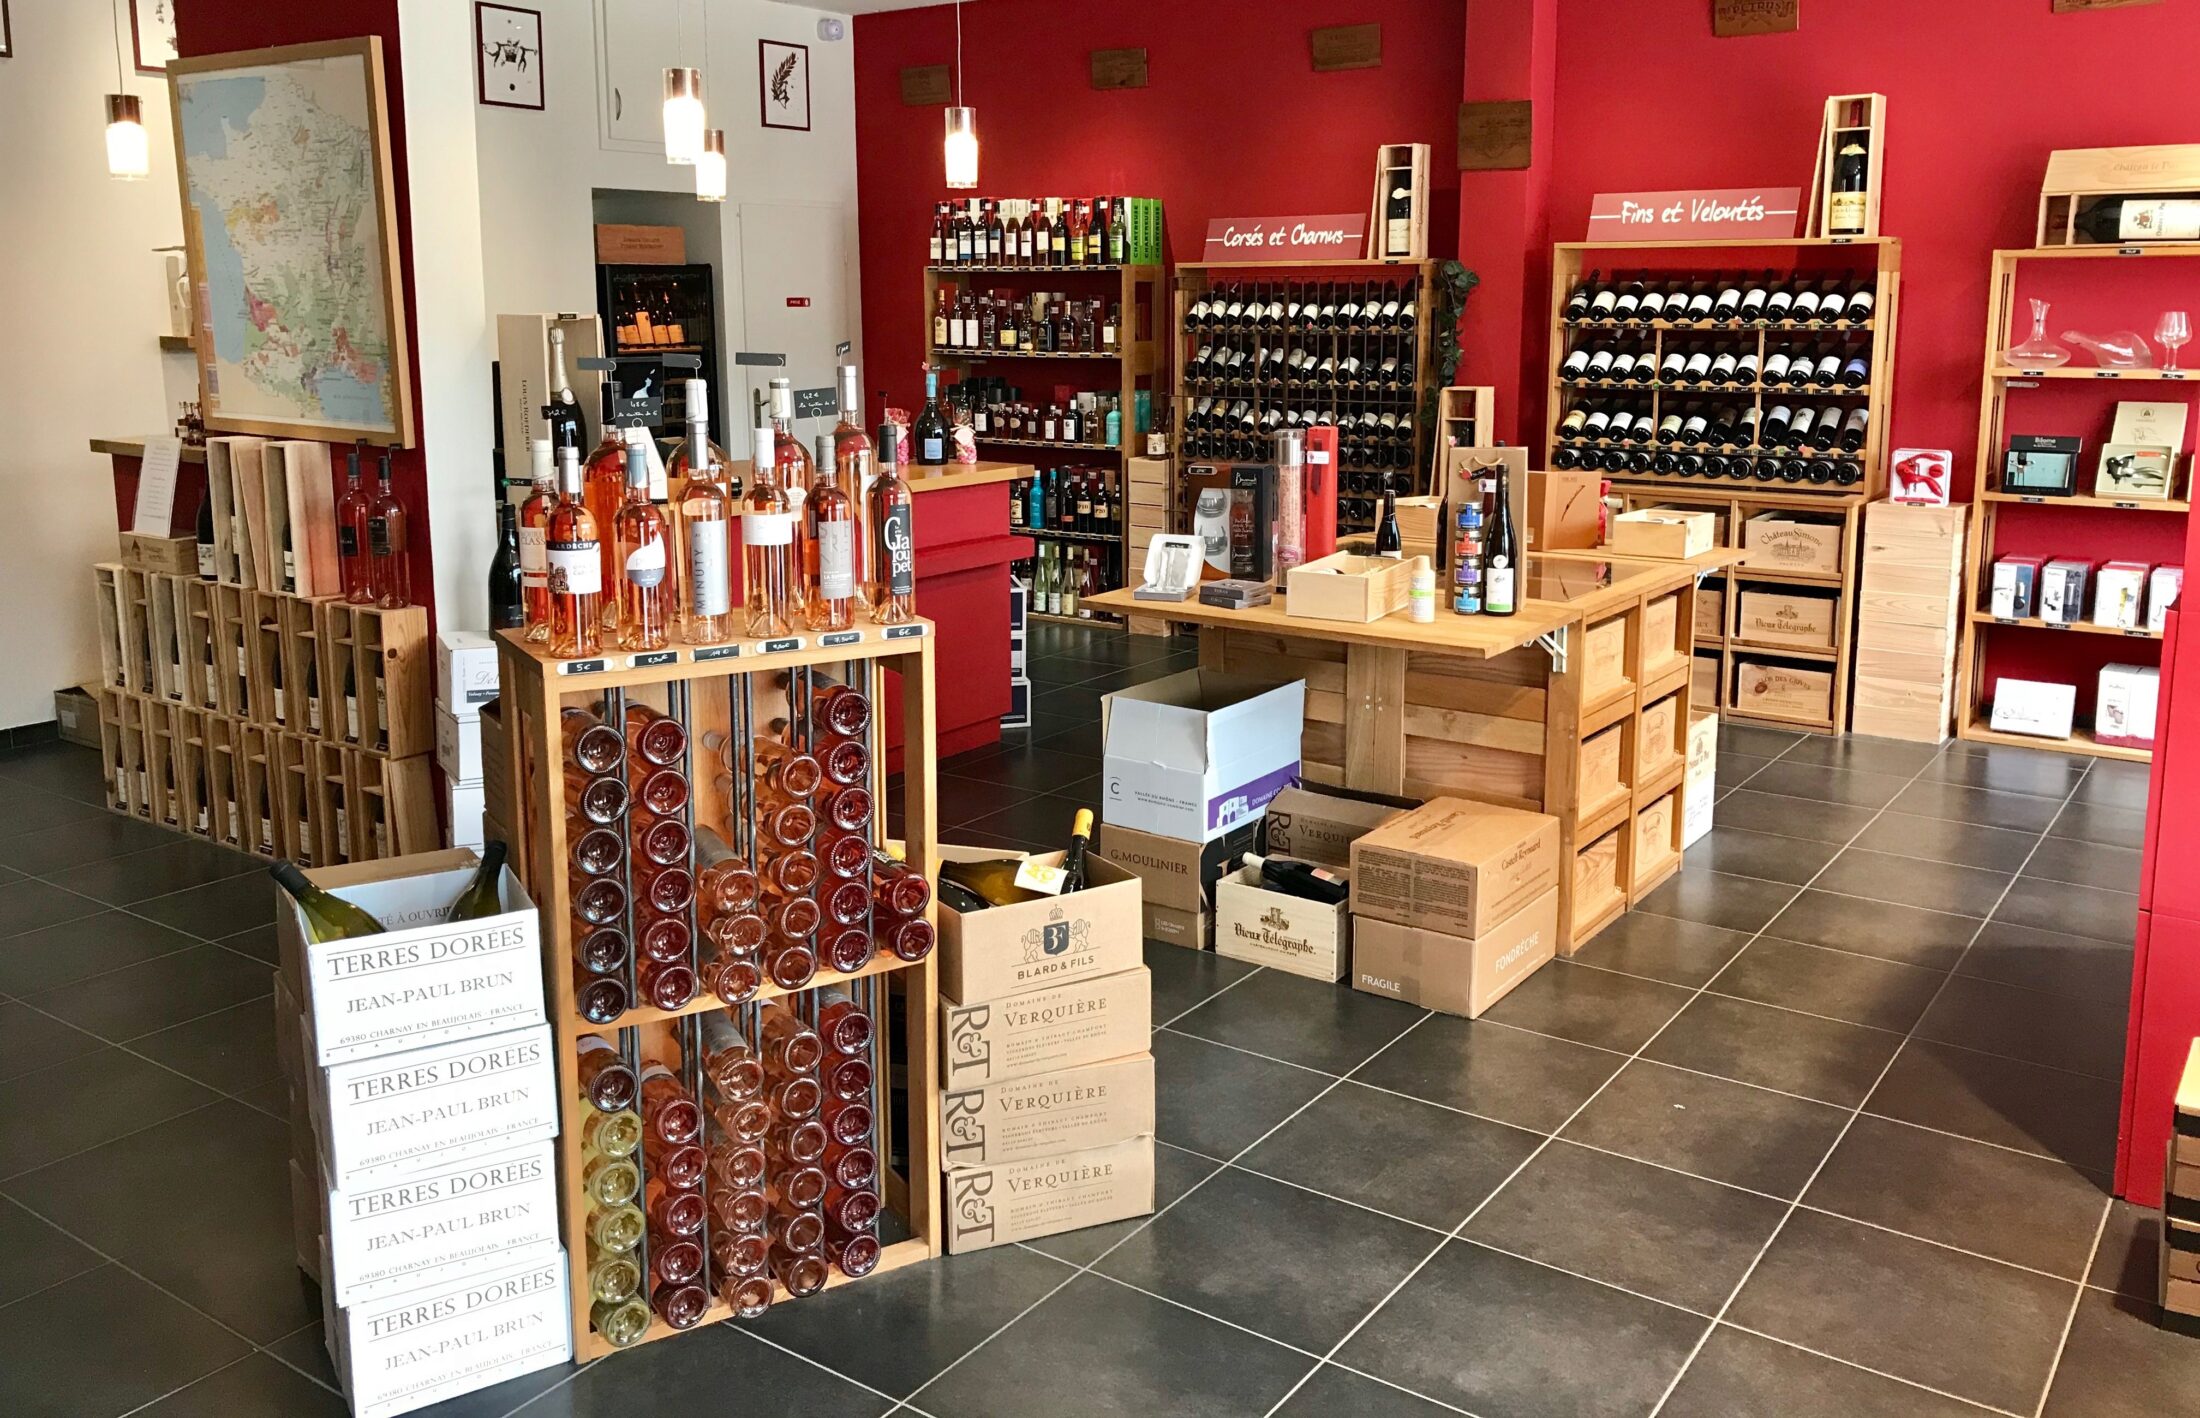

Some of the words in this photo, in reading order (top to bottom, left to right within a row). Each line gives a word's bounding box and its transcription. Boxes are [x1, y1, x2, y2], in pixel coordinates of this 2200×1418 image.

[1620, 200, 1654, 225] Fins
[1661, 200, 1684, 223] et
[1691, 195, 1765, 223] Veloutés
[1223, 224, 1264, 248] Corsés
[1268, 226, 1286, 246] et
[1290, 223, 1344, 246] Charnus
[1760, 530, 1793, 545] Château
[1793, 527, 1823, 547] Simone
[694, 549, 706, 610] MINUTY
[898, 627, 911, 636] 6€
[1755, 618, 1775, 630] Vieux
[1299, 824, 1351, 844] VERQUI
[1110, 849, 1189, 876] G.MOULINIER
[1233, 922, 1262, 942] Vieux
[327, 944, 419, 977] TERRES
[431, 926, 524, 960] DORÉES
[1495, 931, 1540, 974] FONDRÈCHE
[1017, 962, 1058, 981] BLARD
[1060, 960, 1068, 970] &
[1070, 955, 1095, 969] FILS
[346, 983, 456, 1014] JEAN-PAUL
[460, 971, 514, 993] BRUN
[1361, 974, 1400, 993] FRAGILE
[1004, 997, 1108, 1027] VERQUIÈRE
[1006, 995, 1047, 1009] DOMAINE
[339, 1032, 367, 1045] 69380
[369, 1024, 413, 1040] CHARNAY
[951, 1004, 991, 1078] R&T
[348, 1066, 439, 1100] TERRES
[449, 1043, 541, 1079] DORÉES
[1000, 1081, 1043, 1094] DOMAINE
[1000, 1085, 1108, 1113] VERQUIÈRE
[366, 1101, 474, 1136] JEAN-PAUL
[478, 1087, 530, 1110] BRUN
[945, 1088, 986, 1162] R&T
[1007, 1163, 1114, 1194] VERQUIÈRE
[1009, 1162, 1050, 1175] DOMAINE
[348, 1181, 440, 1217] TERRES
[450, 1159, 542, 1195] DORÉES
[954, 1170, 995, 1243] R&T
[366, 1217, 474, 1252] JEAN-PAUL
[478, 1202, 531, 1226] BRUN
[367, 1297, 456, 1338] TERRES
[466, 1269, 555, 1310] DORÉES
[384, 1329, 489, 1371] JEAN-PAUL
[493, 1311, 544, 1338] BRUN
